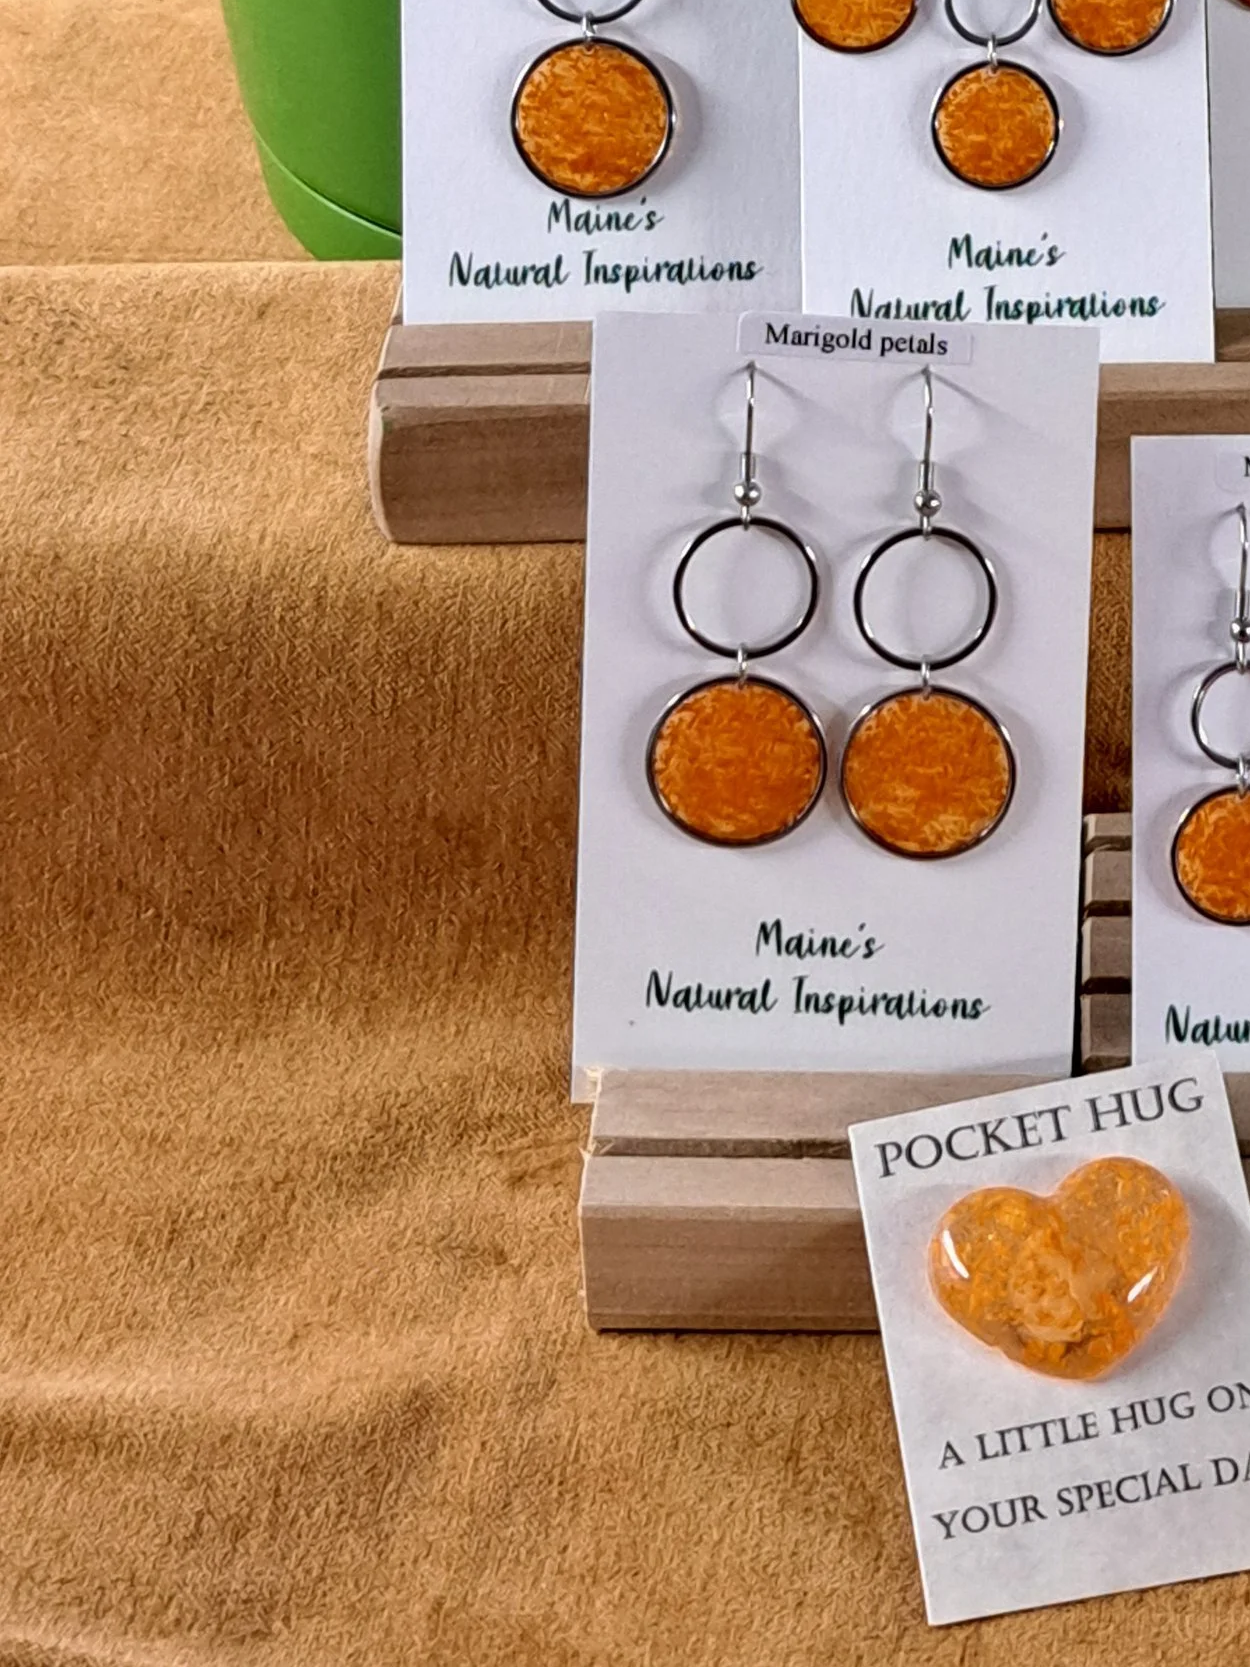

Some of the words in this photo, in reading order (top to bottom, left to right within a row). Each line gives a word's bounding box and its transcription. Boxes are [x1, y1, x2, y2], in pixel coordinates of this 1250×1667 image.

[548, 198, 663, 235] Maine's
[450, 252, 568, 289] Natural
[585, 251, 762, 293] Inspirations
[949, 233, 1063, 271] Maine's
[851, 288, 970, 321] Natural
[987, 286, 1164, 324] Inspirations
[766, 323, 871, 353] Marigold
[880, 333, 947, 357] petals
[756, 919, 883, 959] Maine's
[647, 971, 777, 1014] Natural
[795, 976, 990, 1025] Inspirations
[877, 1105, 1070, 1177] POCKET
[1087, 1078, 1203, 1131] HUG
[940, 1441, 965, 1468] A
[976, 1413, 1099, 1460] LITTLE
[1111, 1392, 1194, 1434] HUG
[933, 1495, 1047, 1539] YOUR
[1057, 1464, 1201, 1516] SPECIAL
